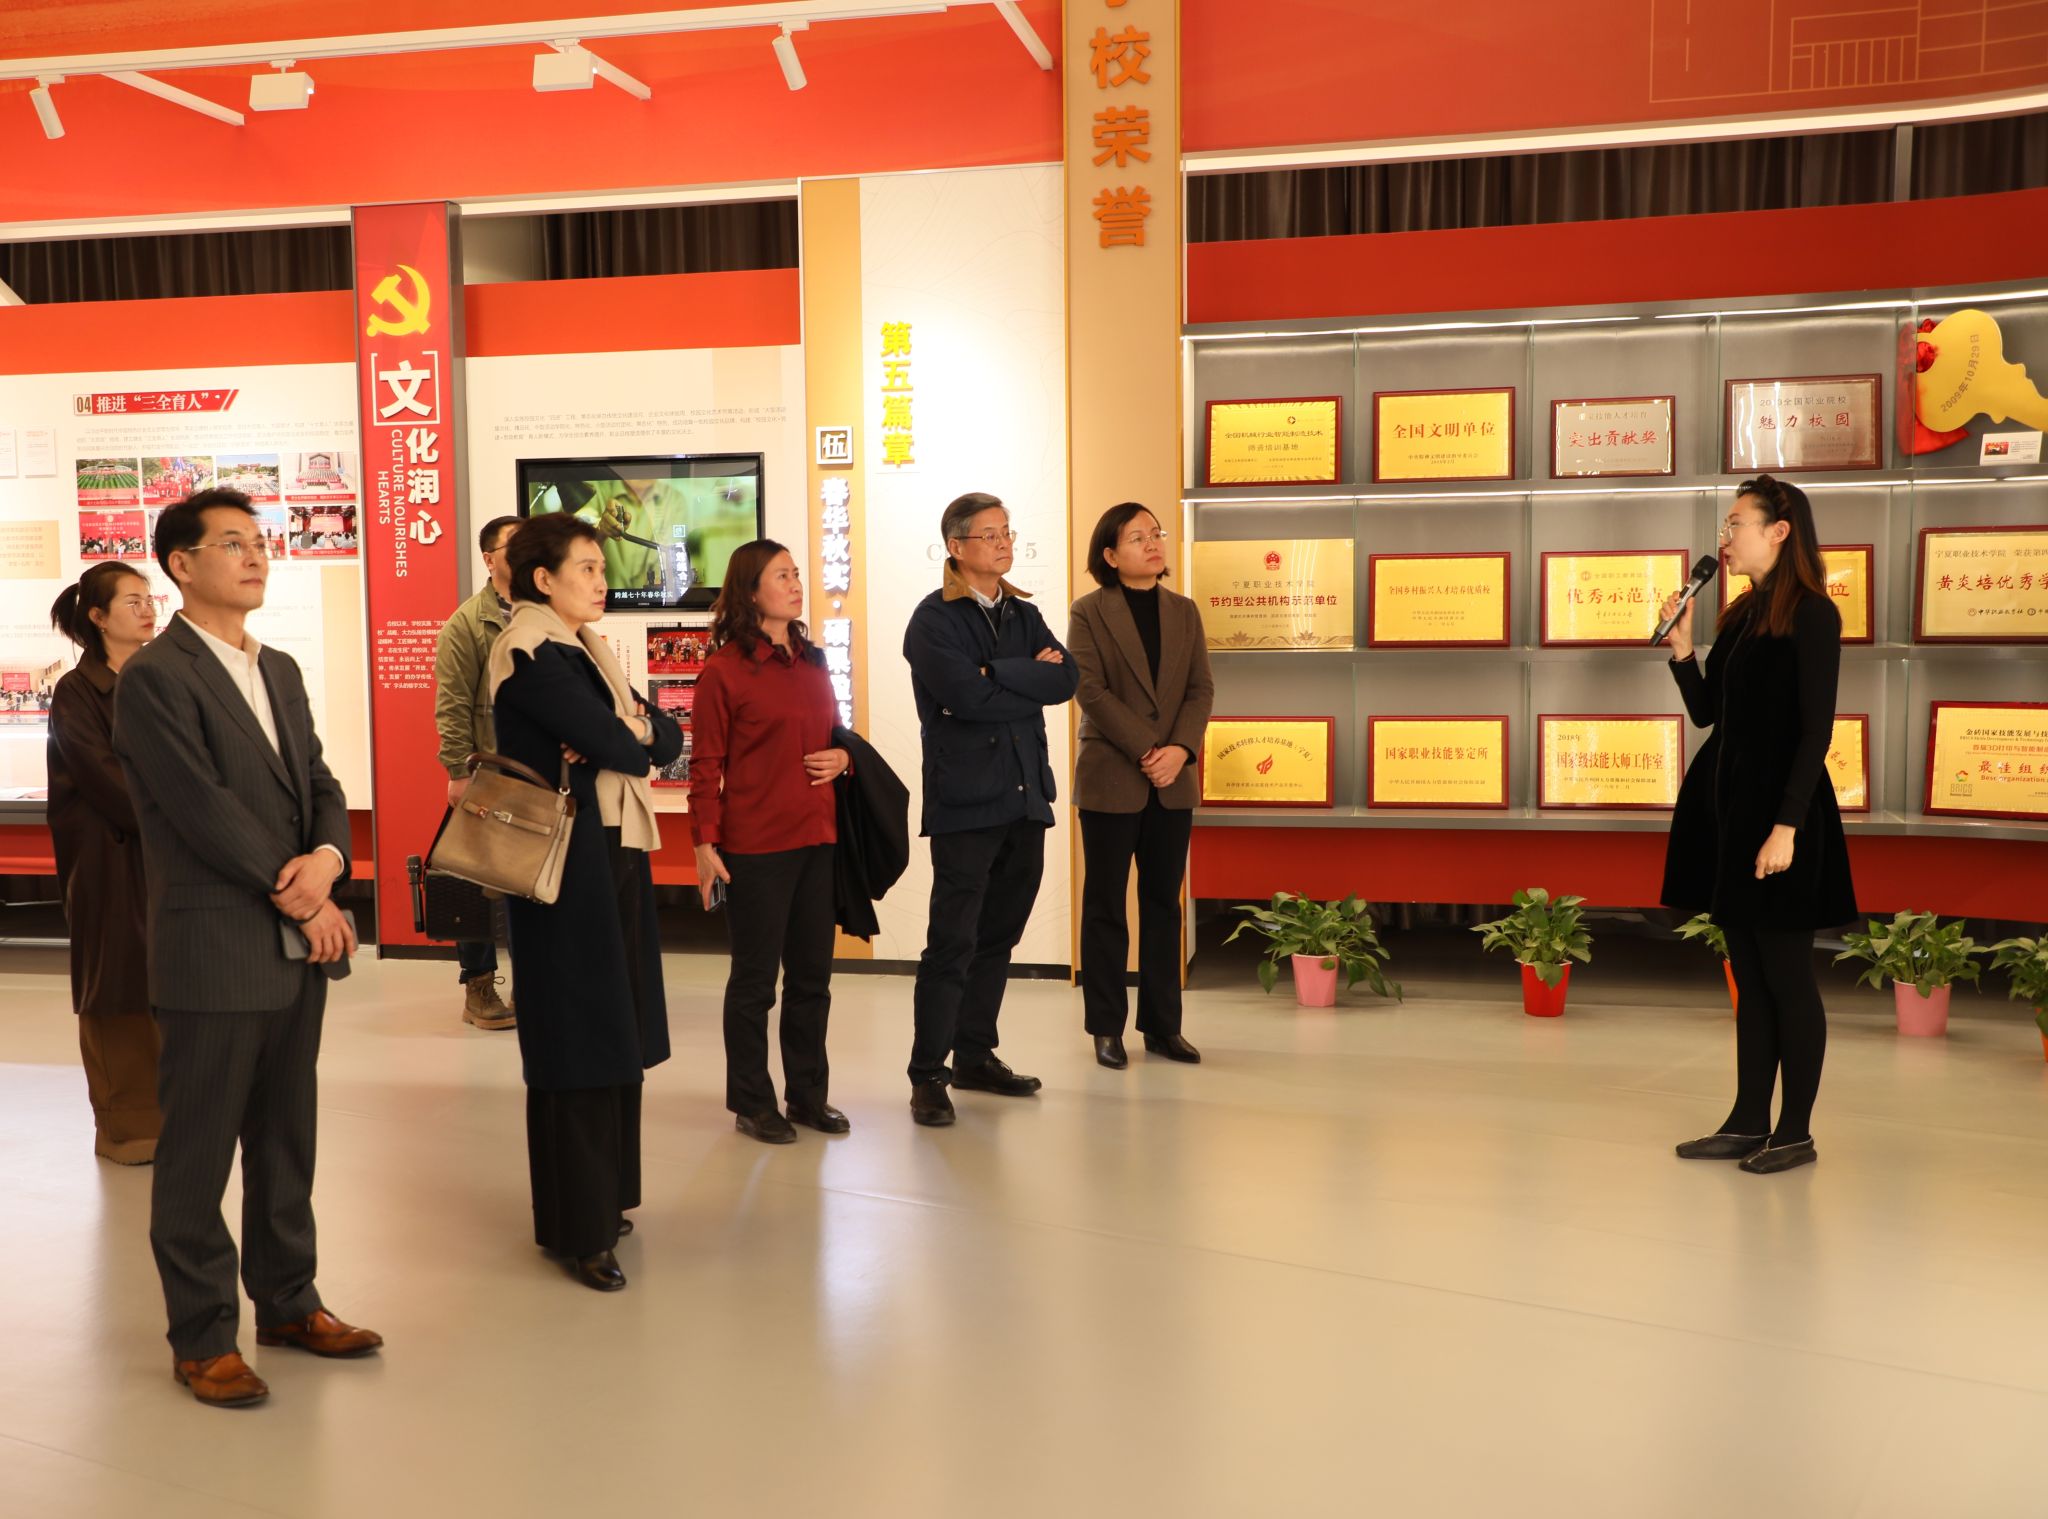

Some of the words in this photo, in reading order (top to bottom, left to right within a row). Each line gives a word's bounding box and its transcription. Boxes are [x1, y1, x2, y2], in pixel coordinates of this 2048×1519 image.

[1089, 0, 1151, 249] 校荣誉
[1940, 334, 1980, 412] 2009年10月29日
[880, 321, 915, 467] 第五篇章
[76, 396, 92, 413] 04
[1759, 412, 1850, 430] 魅力校园
[1393, 422, 1496, 438] 全国文明单位
[1569, 430, 1658, 447] 突出贡献奖
[822, 433, 849, 460] 伍
[391, 429, 405, 491] CULTURE
[378, 471, 390, 525] HEARTS
[393, 496, 408, 577] NOURISHES
[1935, 549, 2006, 558] 宁夏职业技术学院
[1232, 580, 1315, 589] 宁夏职业技术学院
[1210, 595, 1337, 607] 节约型公共机构示范单位
[1567, 588, 1664, 604] 优秀示范点
[1385, 746, 1488, 760] 国家职业技能鉴定所
[1557, 751, 1664, 770] 国家级技能大师工作室
[1950, 783, 1973, 793] BRICS
